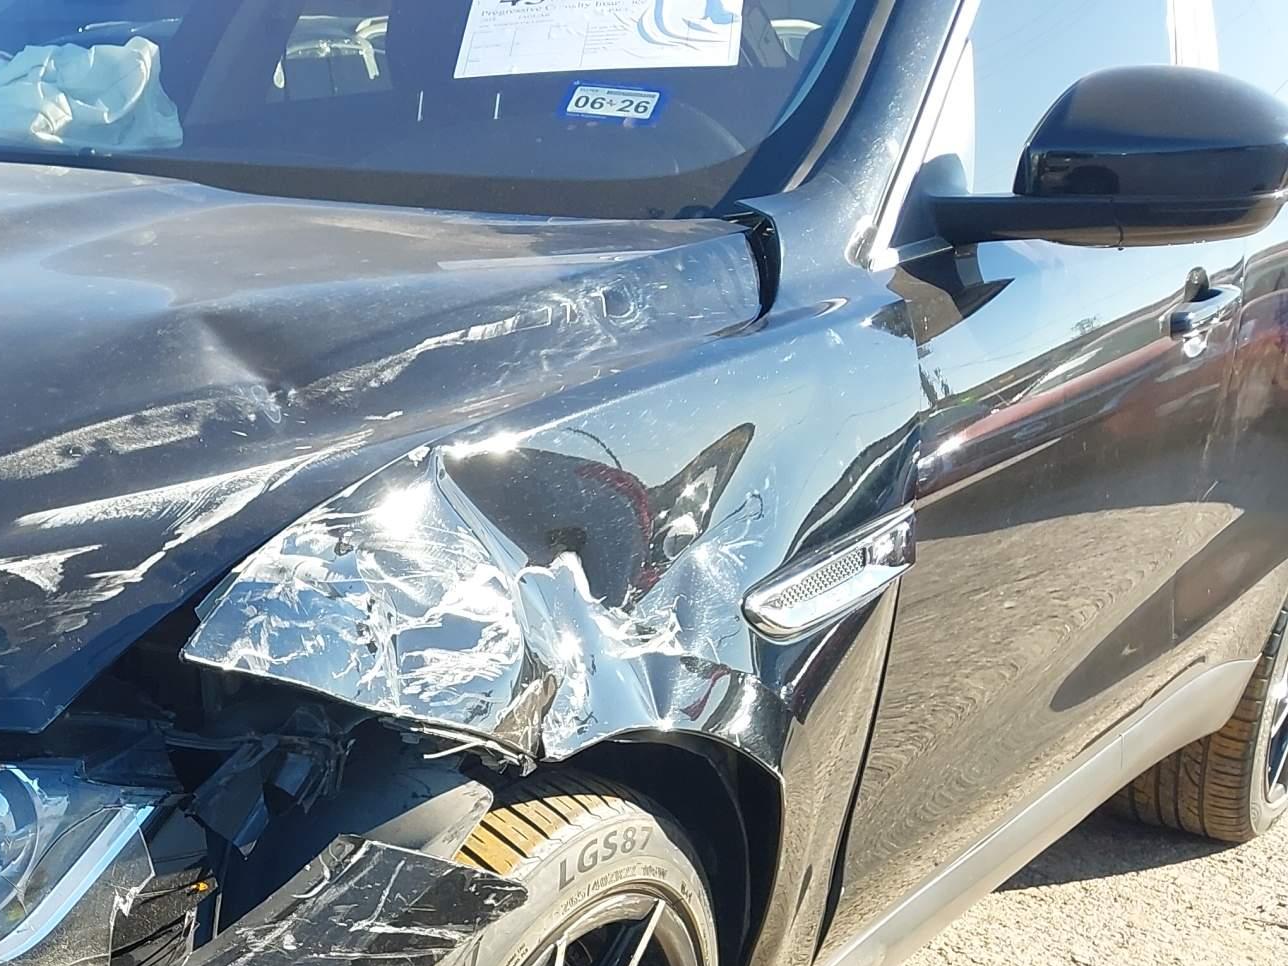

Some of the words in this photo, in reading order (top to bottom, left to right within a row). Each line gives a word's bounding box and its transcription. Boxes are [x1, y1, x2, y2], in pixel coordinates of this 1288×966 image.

[574, 95, 606, 110] 06
[616, 99, 651, 114] 26
[558, 826, 653, 891] LGS87
